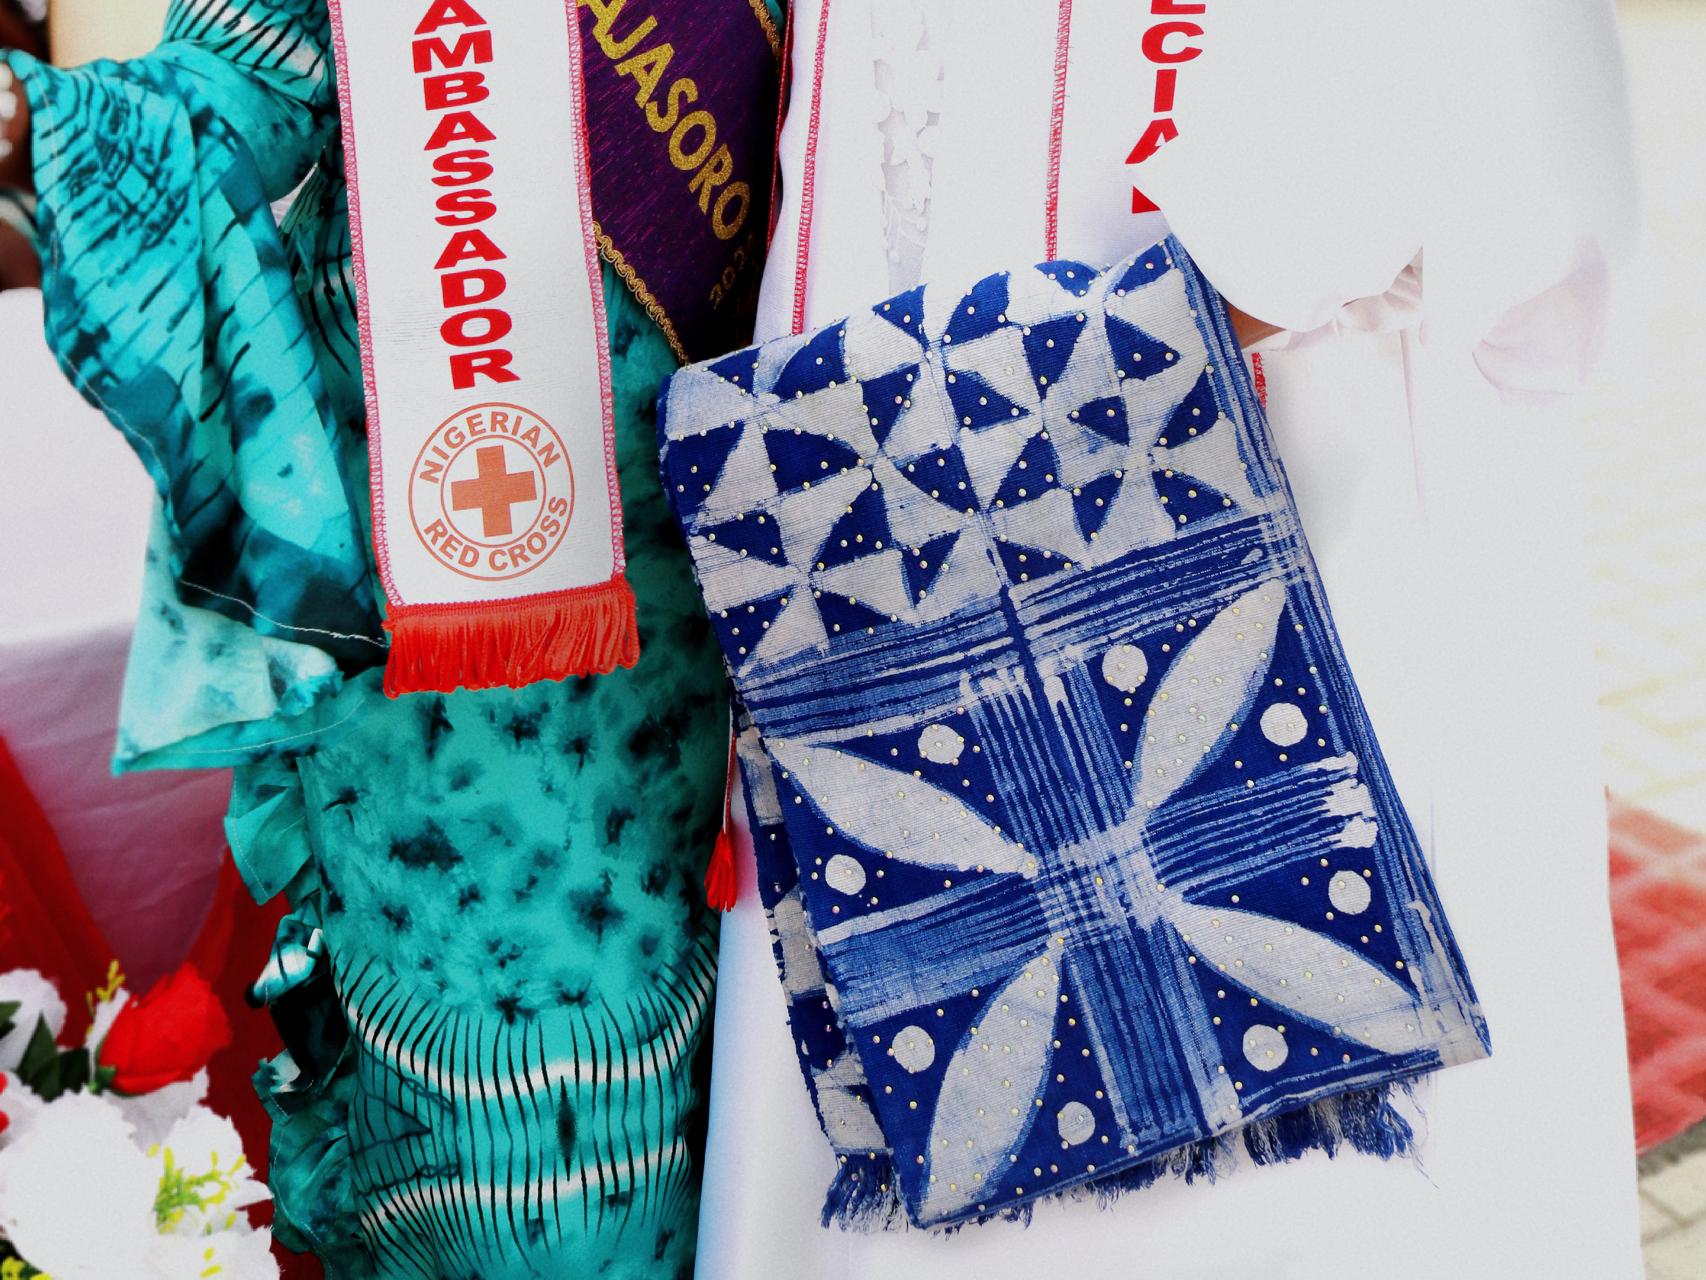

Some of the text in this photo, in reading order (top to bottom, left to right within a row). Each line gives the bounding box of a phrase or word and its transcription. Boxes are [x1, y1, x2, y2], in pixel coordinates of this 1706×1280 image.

[419, 411, 561, 484] NIGERIAN
[424, 496, 568, 572] RED CROSS
